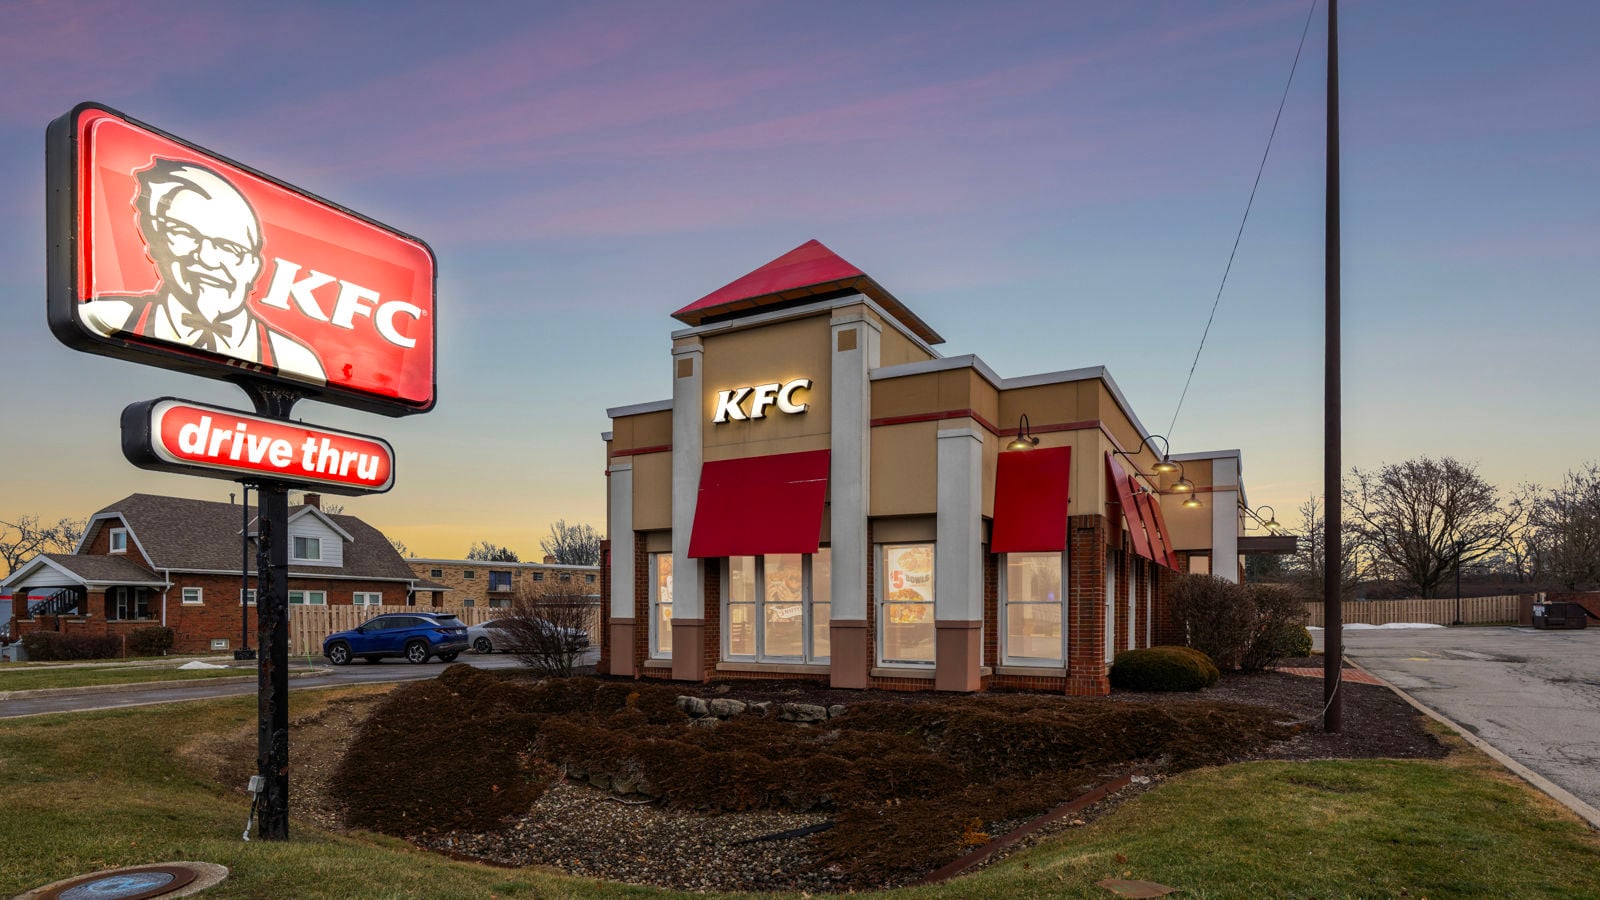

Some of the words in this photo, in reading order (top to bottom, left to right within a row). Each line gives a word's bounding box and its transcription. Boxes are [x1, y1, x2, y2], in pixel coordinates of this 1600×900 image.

[260, 257, 421, 348] KFC
[712, 378, 812, 424] KFC
[178, 416, 293, 467] drive
[301, 438, 380, 481] thru
[905, 574, 930, 584] BOWLS
